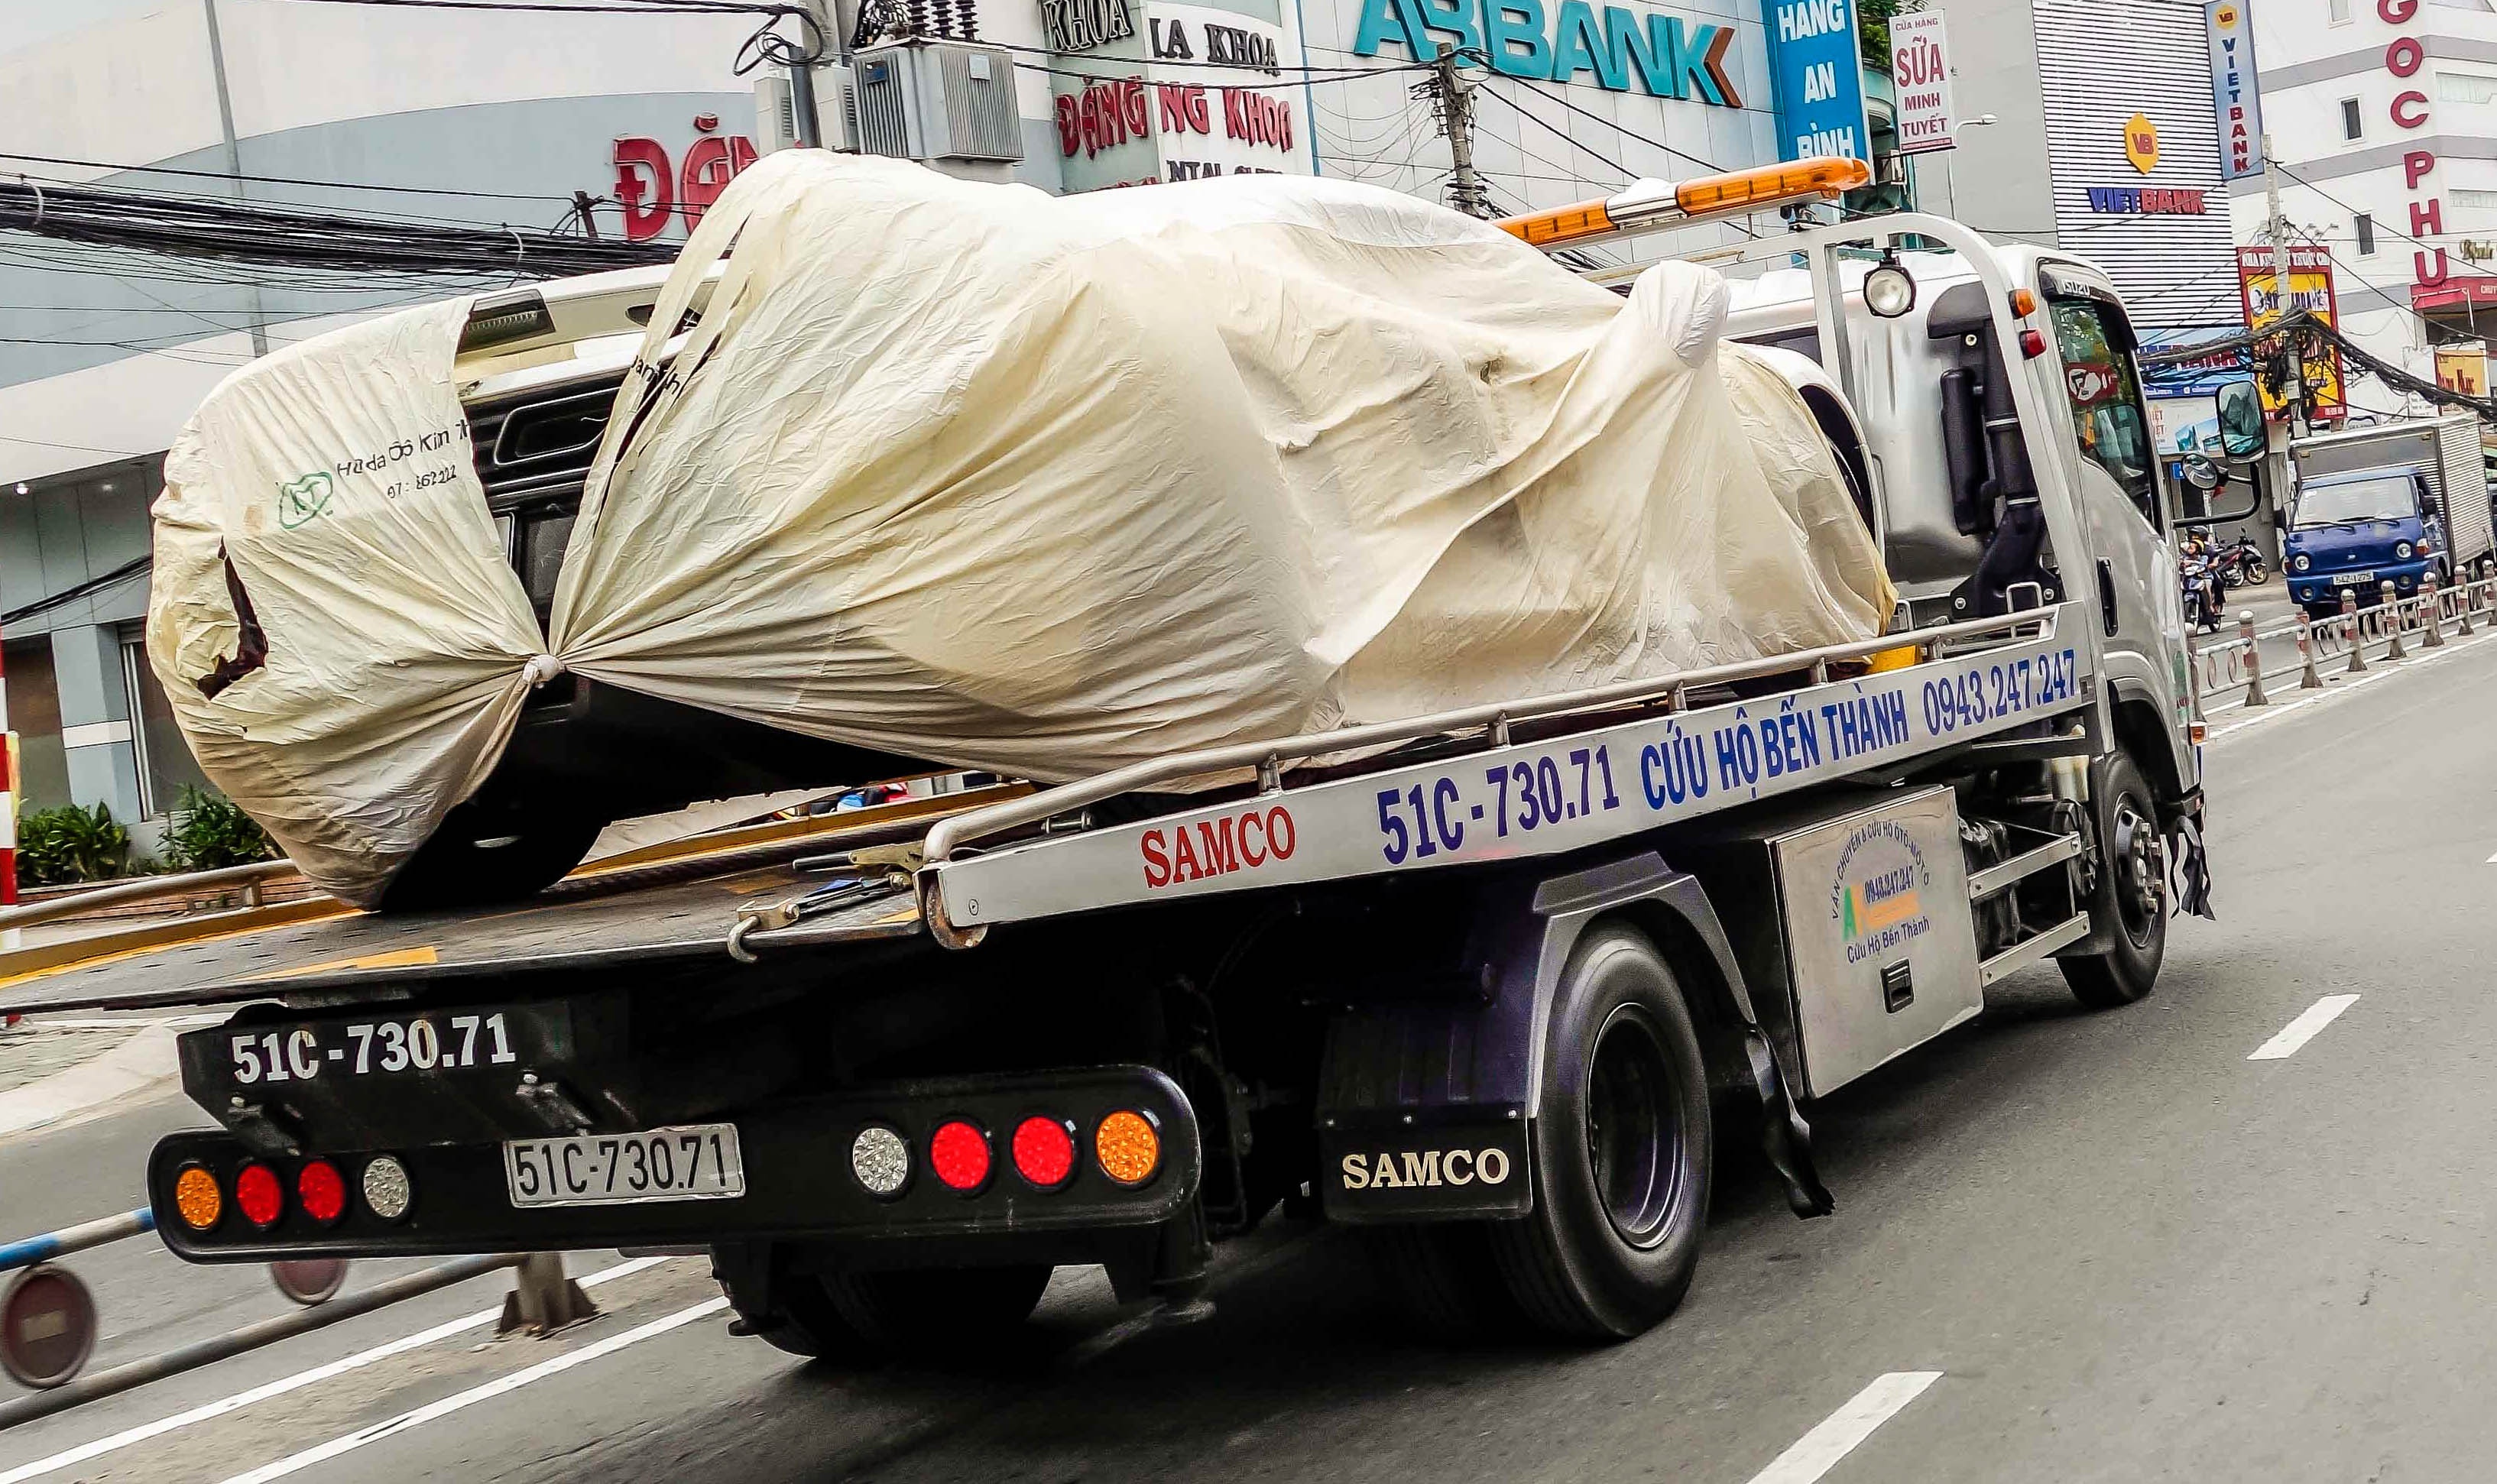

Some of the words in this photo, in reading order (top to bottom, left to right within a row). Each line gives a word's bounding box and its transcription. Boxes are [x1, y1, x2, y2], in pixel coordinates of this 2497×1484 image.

[1042, 0, 1135, 51] KHOA
[1205, 24, 1280, 76] KHOA
[1896, 35, 1945, 88] SỮA
[1804, 61, 1837, 104] AN
[1905, 92, 1941, 112] MINH
[1224, 87, 1293, 153] KHOA
[1797, 122, 1856, 159] BÌNH
[1901, 113, 1947, 138] TUYẾT
[2087, 187, 2207, 214] VIETBANK
[2063, 280, 2090, 296] ISUZU
[1140, 805, 1296, 889] SAMCO
[1376, 744, 1620, 867] 51C-730.71
[1640, 721, 1707, 810] CỨU
[1714, 707, 1759, 799] HỘ
[1757, 695, 1821, 779] BẾN
[1823, 683, 1909, 753] THÀNH
[1922, 649, 2077, 736] 0943.247.247
[1901, 915, 1931, 941] Thành
[232, 1012, 517, 1085] 51C-730.71
[515, 1132, 727, 1197] 51C-730.71
[1341, 1148, 1510, 1189] SAMCO
